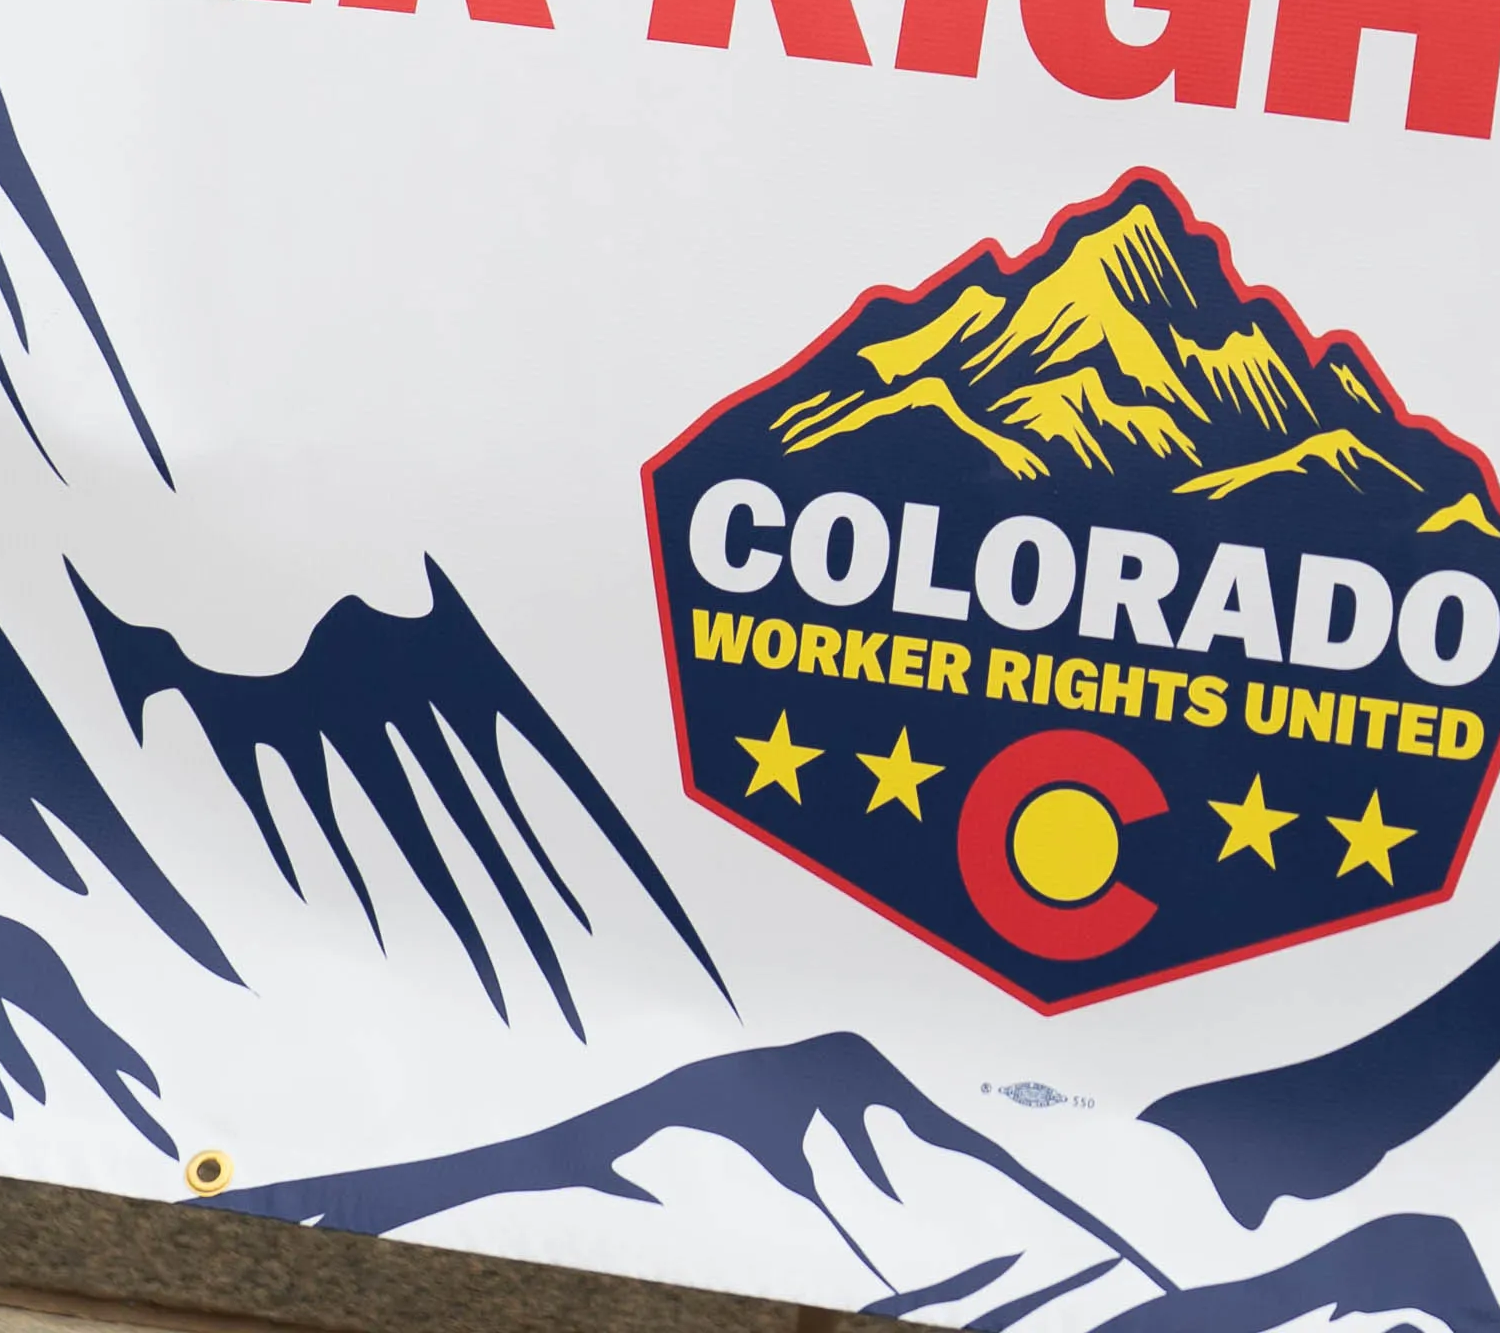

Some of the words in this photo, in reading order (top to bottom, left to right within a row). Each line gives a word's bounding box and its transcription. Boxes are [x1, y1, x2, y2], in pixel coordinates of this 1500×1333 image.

[690, 607, 972, 697] WORKER
[984, 647, 1229, 729] RIGHTS
[1243, 681, 1486, 762] UNITED
